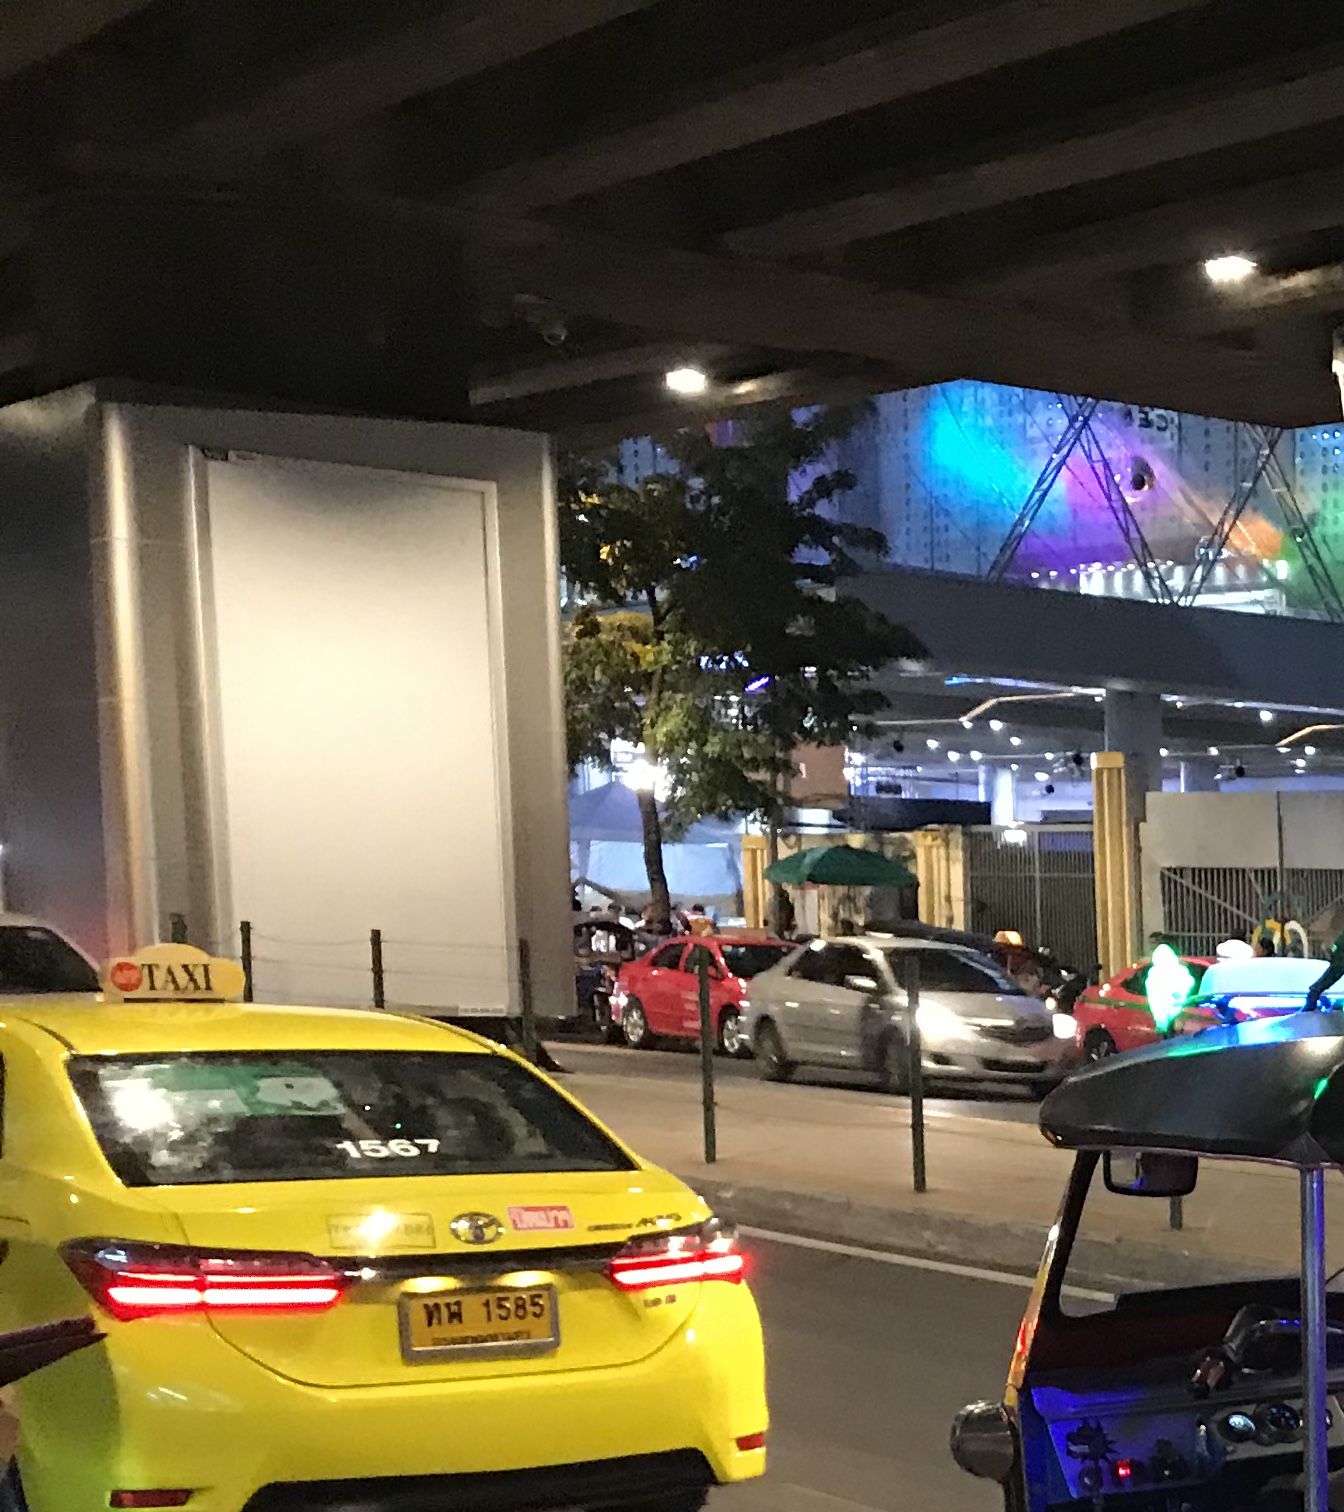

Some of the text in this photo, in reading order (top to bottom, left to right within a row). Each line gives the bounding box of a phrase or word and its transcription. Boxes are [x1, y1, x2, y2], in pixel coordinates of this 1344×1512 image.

[141, 963, 213, 993] TAXI
[336, 1139, 440, 1158] 1567
[482, 1293, 545, 1322] 1585
